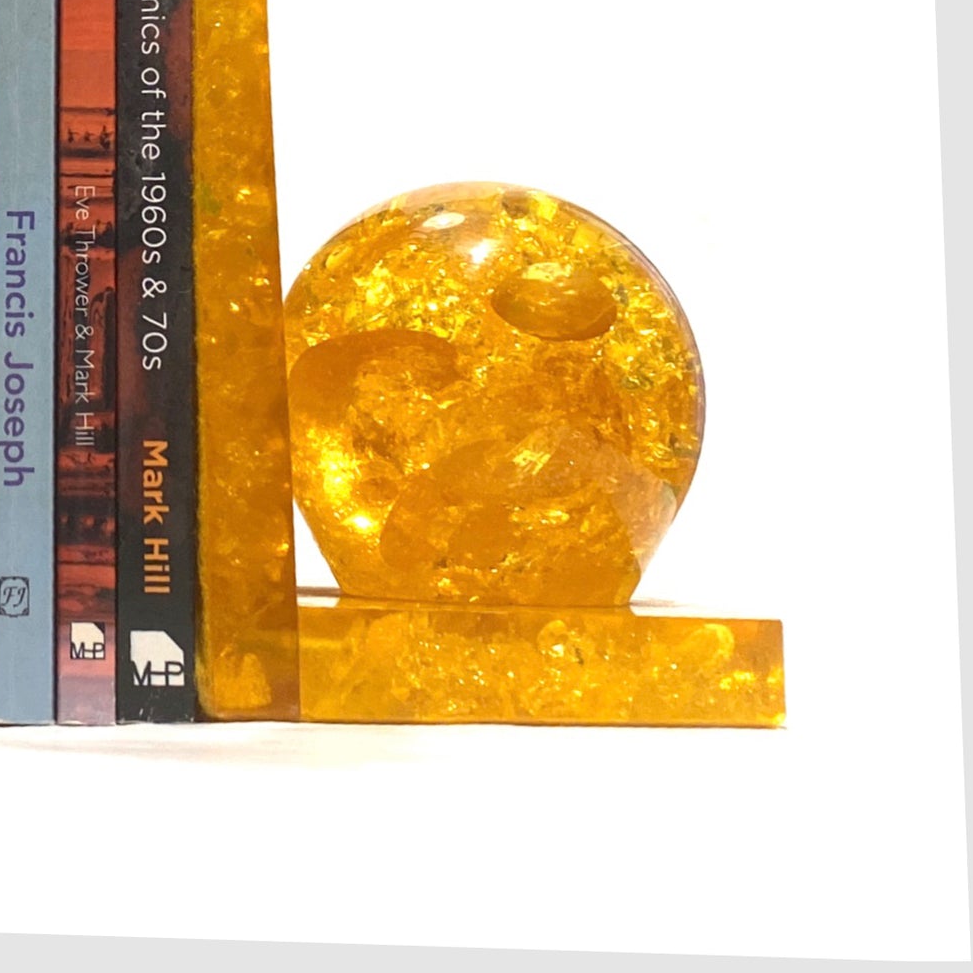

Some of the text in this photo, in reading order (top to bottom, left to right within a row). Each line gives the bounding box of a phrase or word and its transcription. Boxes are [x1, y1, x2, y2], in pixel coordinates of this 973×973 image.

[141, 68, 167, 97] of
[141, 106, 167, 159] the
[140, 172, 167, 265] 1960s
[5, 210, 35, 338] Francis
[140, 278, 167, 300] &
[73, 185, 96, 446] Eve Thrower & Mark Hill
[141, 312, 167, 370] 70s
[142, 440, 171, 594] Mark Hill
